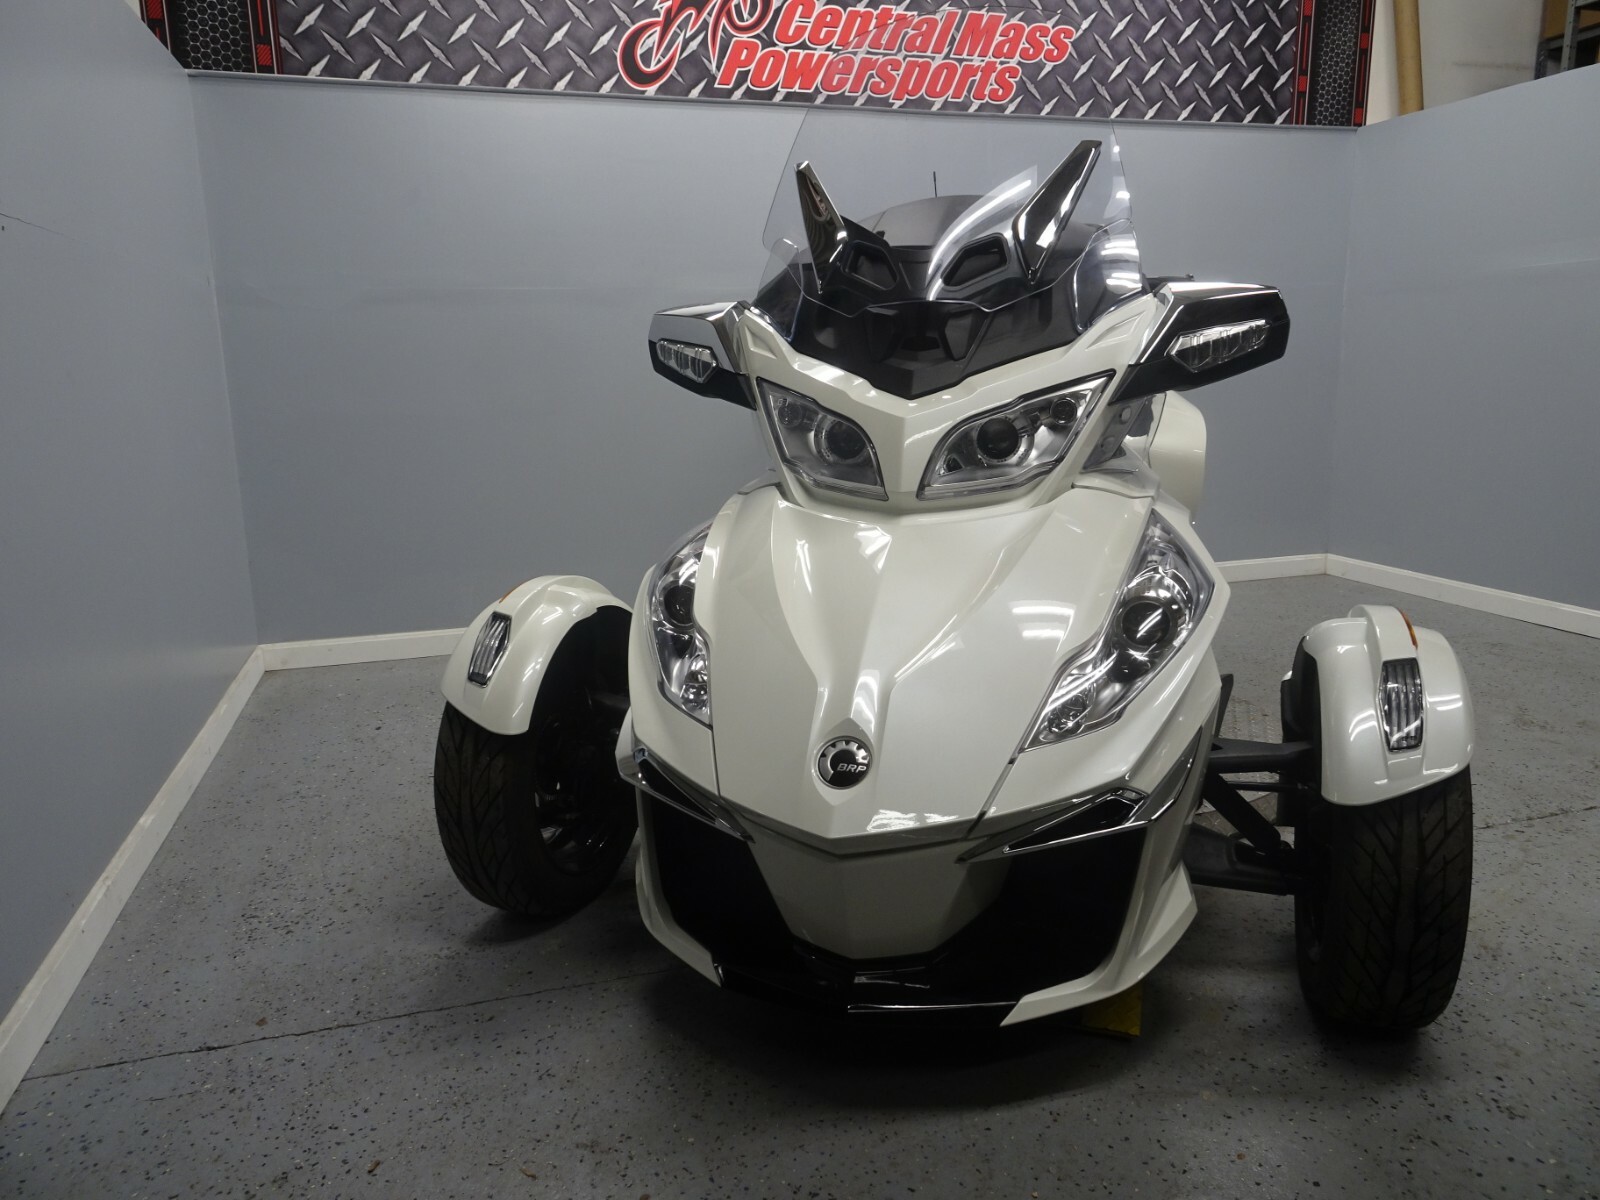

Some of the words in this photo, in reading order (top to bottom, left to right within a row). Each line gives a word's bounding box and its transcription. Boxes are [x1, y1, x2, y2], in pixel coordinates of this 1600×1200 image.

[774, 0, 960, 55] Central
[951, 11, 1076, 63] Mass
[714, 37, 1021, 103] Powersports
[837, 763, 867, 773] BRP
